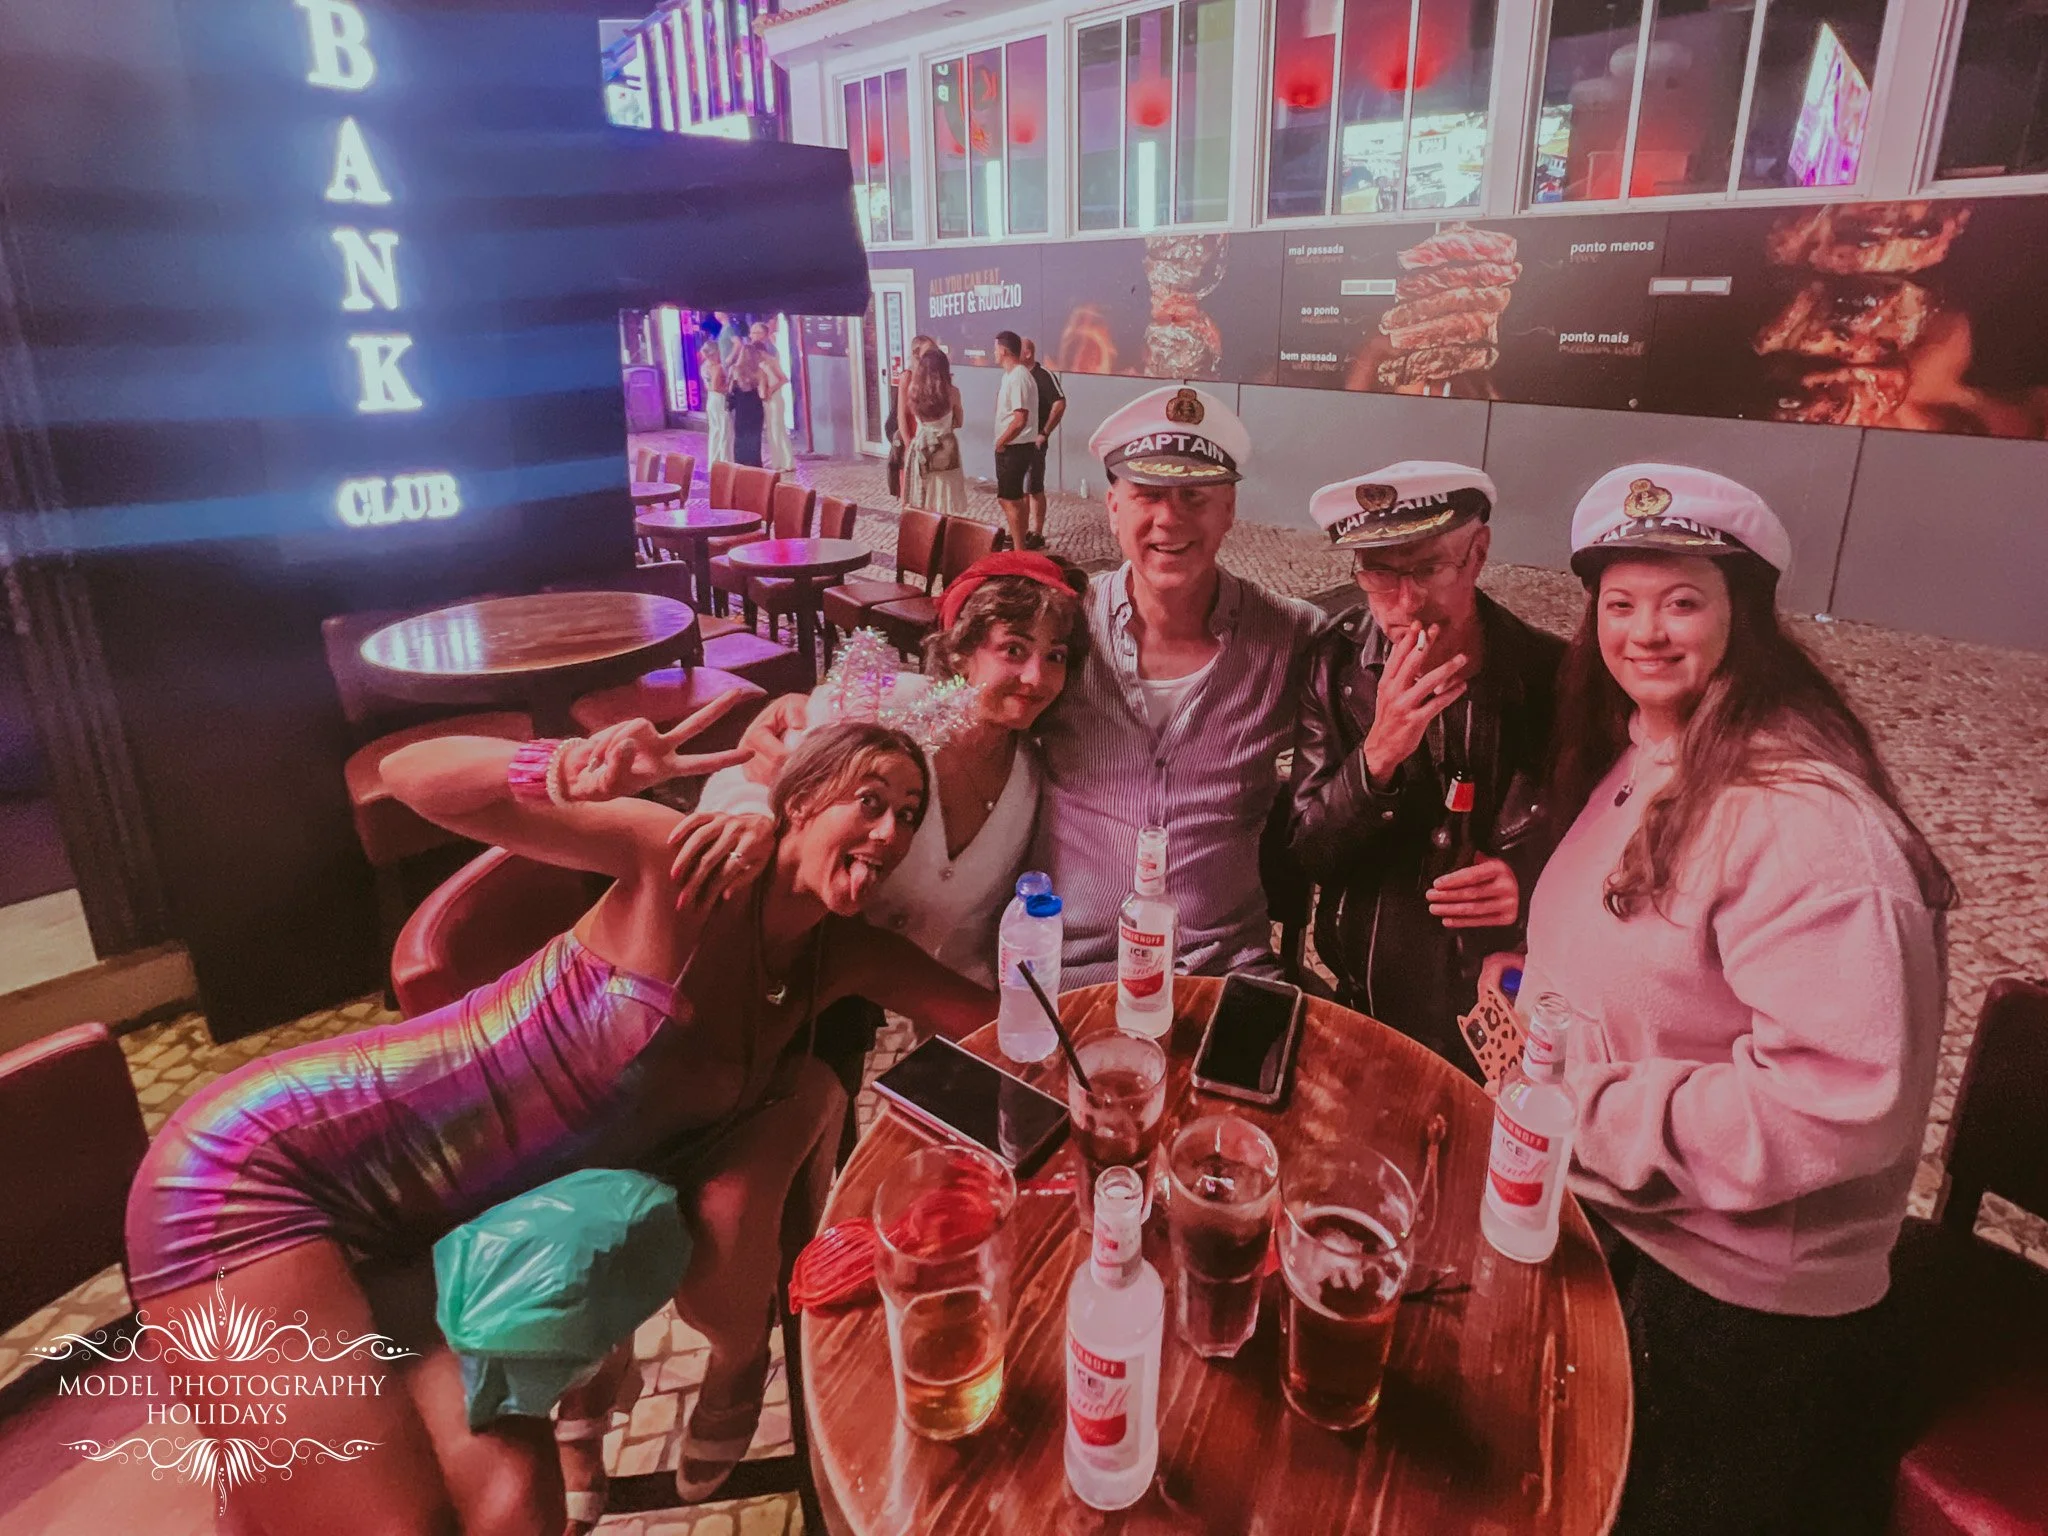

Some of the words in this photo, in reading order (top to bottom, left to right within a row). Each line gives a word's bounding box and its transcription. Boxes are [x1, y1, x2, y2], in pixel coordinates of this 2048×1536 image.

[298, 0, 422, 412] BANK
[1307, 244, 1344, 257] passada
[1570, 242, 1607, 256] ponto
[1610, 241, 1655, 252] menos
[929, 278, 944, 296] ALL
[929, 292, 966, 318] BUFFET
[967, 291, 977, 313] &
[1301, 307, 1312, 315] ao
[1314, 306, 1339, 317] ponto
[1560, 332, 1595, 344] ponto
[1598, 331, 1629, 343] mais
[1280, 351, 1299, 361] bem
[1301, 353, 1337, 363] passada
[1124, 434, 1224, 463] CAPTAIN
[337, 472, 462, 526] CLUB
[1336, 493, 1449, 536] CAPAIN
[1130, 947, 1149, 958] ICE
